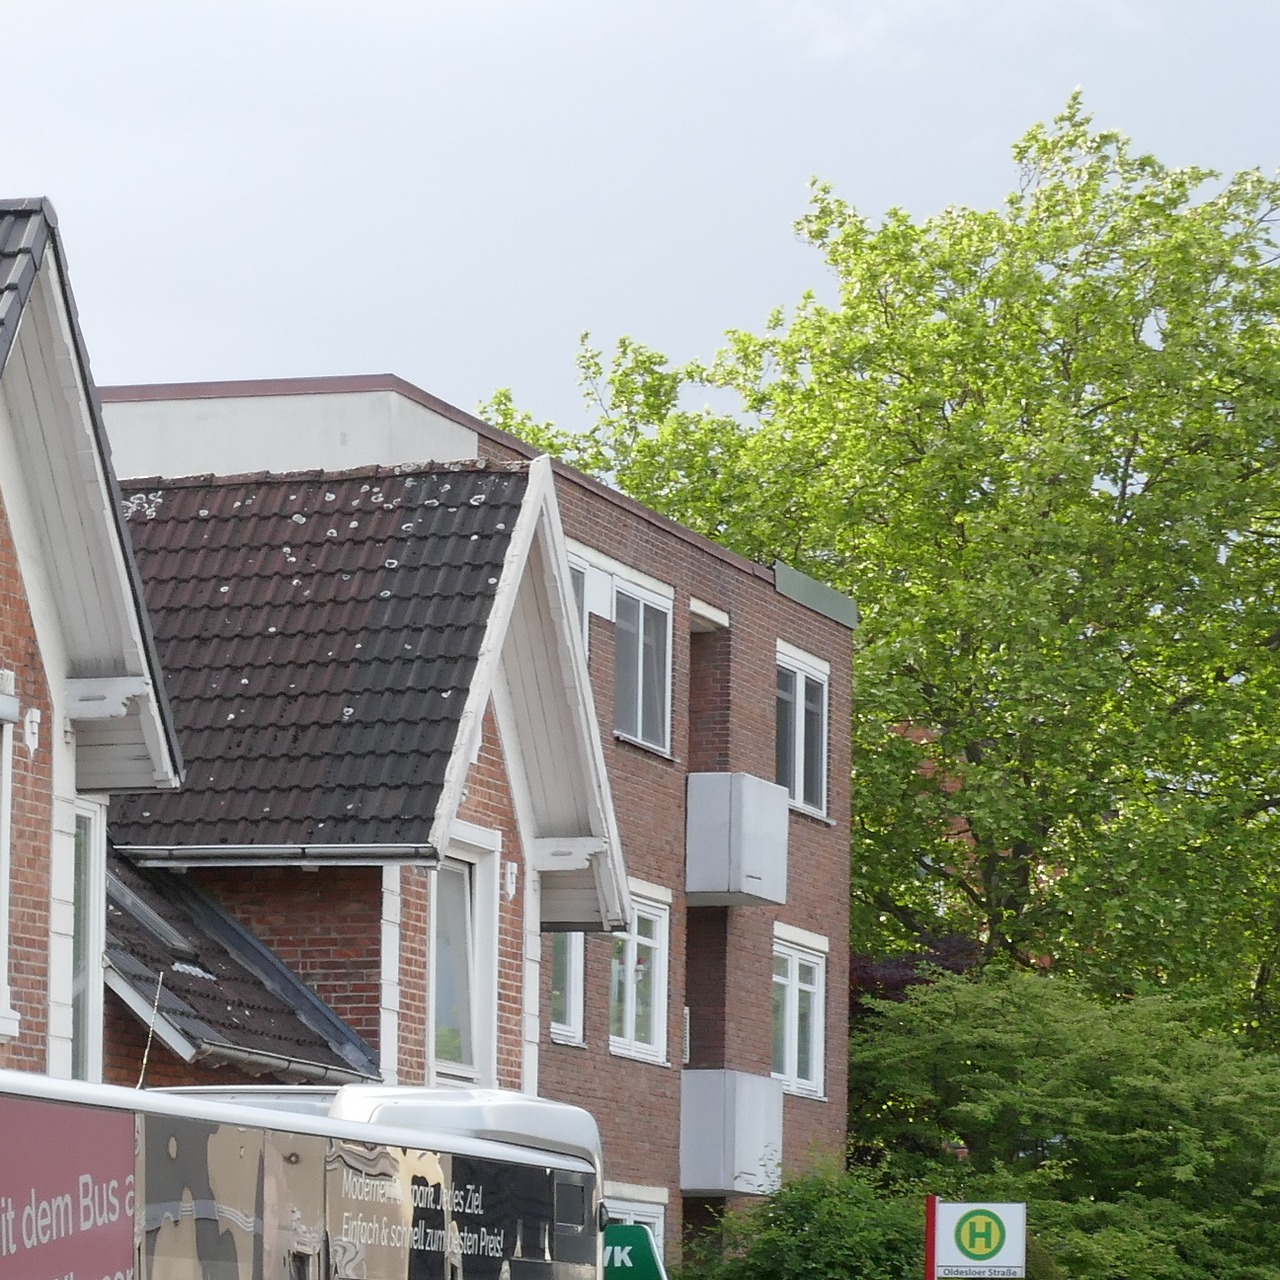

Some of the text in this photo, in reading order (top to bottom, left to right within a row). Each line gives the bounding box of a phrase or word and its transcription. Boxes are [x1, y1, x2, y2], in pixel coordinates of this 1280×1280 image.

[22, 1187, 73, 1250] dem
[78, 1173, 120, 1231] Bus
[342, 1212, 379, 1248] Einfach
[390, 1220, 425, 1250] schnell
[425, 1228, 445, 1252] zum
[479, 1227, 505, 1258] Preis!
[943, 1268, 1017, 1277] Oldesloer Straße
